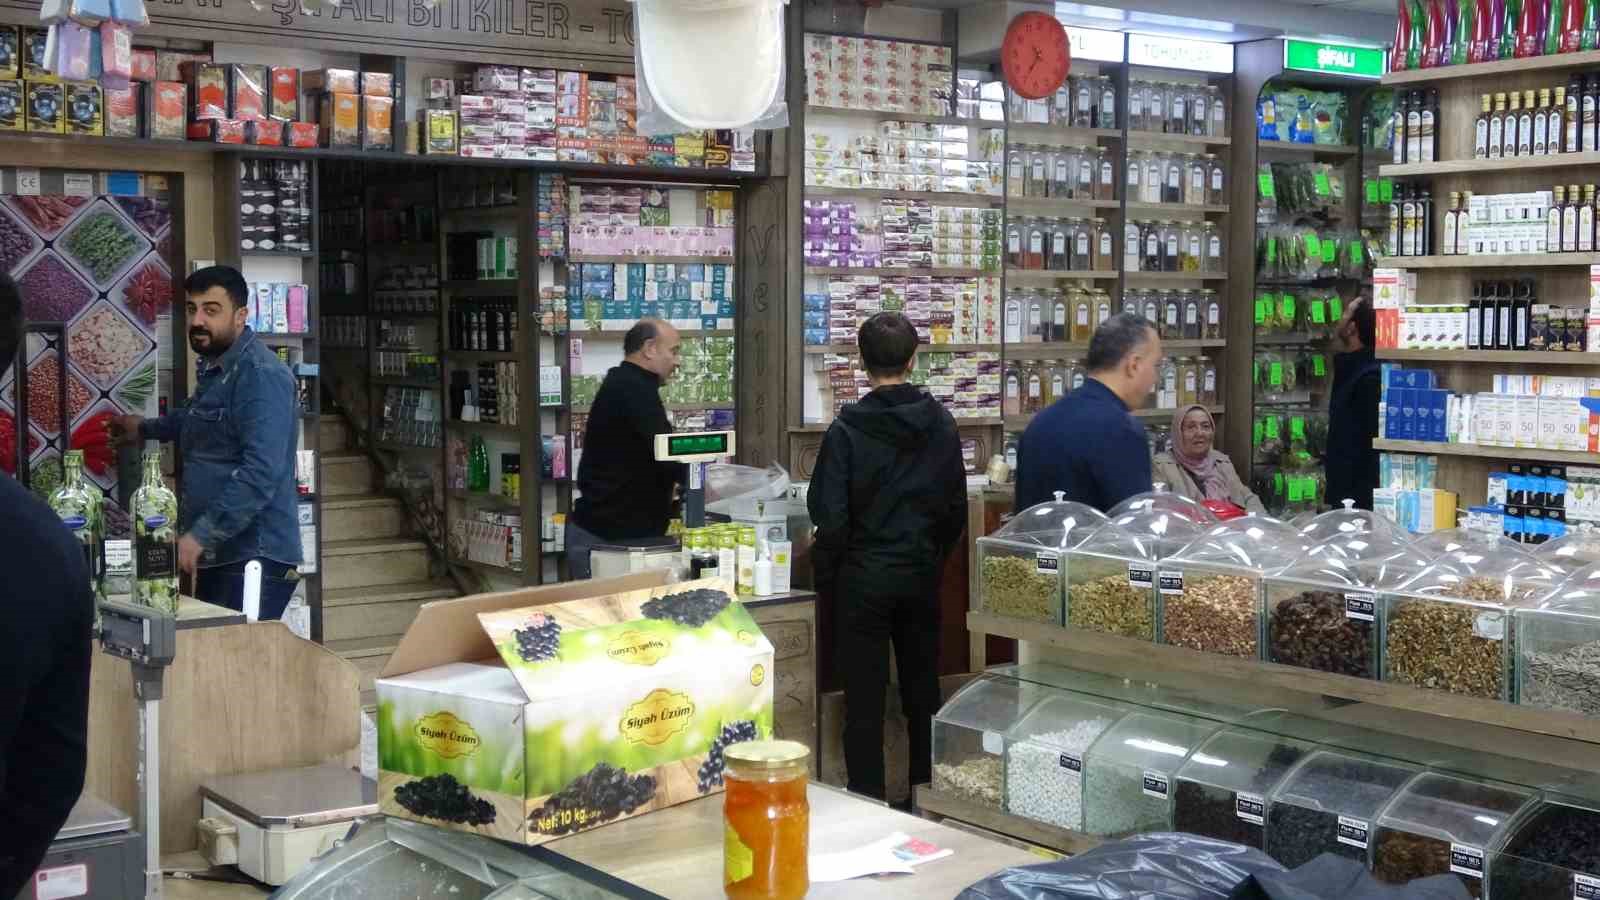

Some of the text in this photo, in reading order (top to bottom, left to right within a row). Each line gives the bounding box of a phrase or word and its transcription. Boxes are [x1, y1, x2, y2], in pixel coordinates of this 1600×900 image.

[627, 704, 691, 731] Siyah Üzüm
[419, 726, 478, 745] Siyah Üzüm
[560, 810, 572, 825] 10
